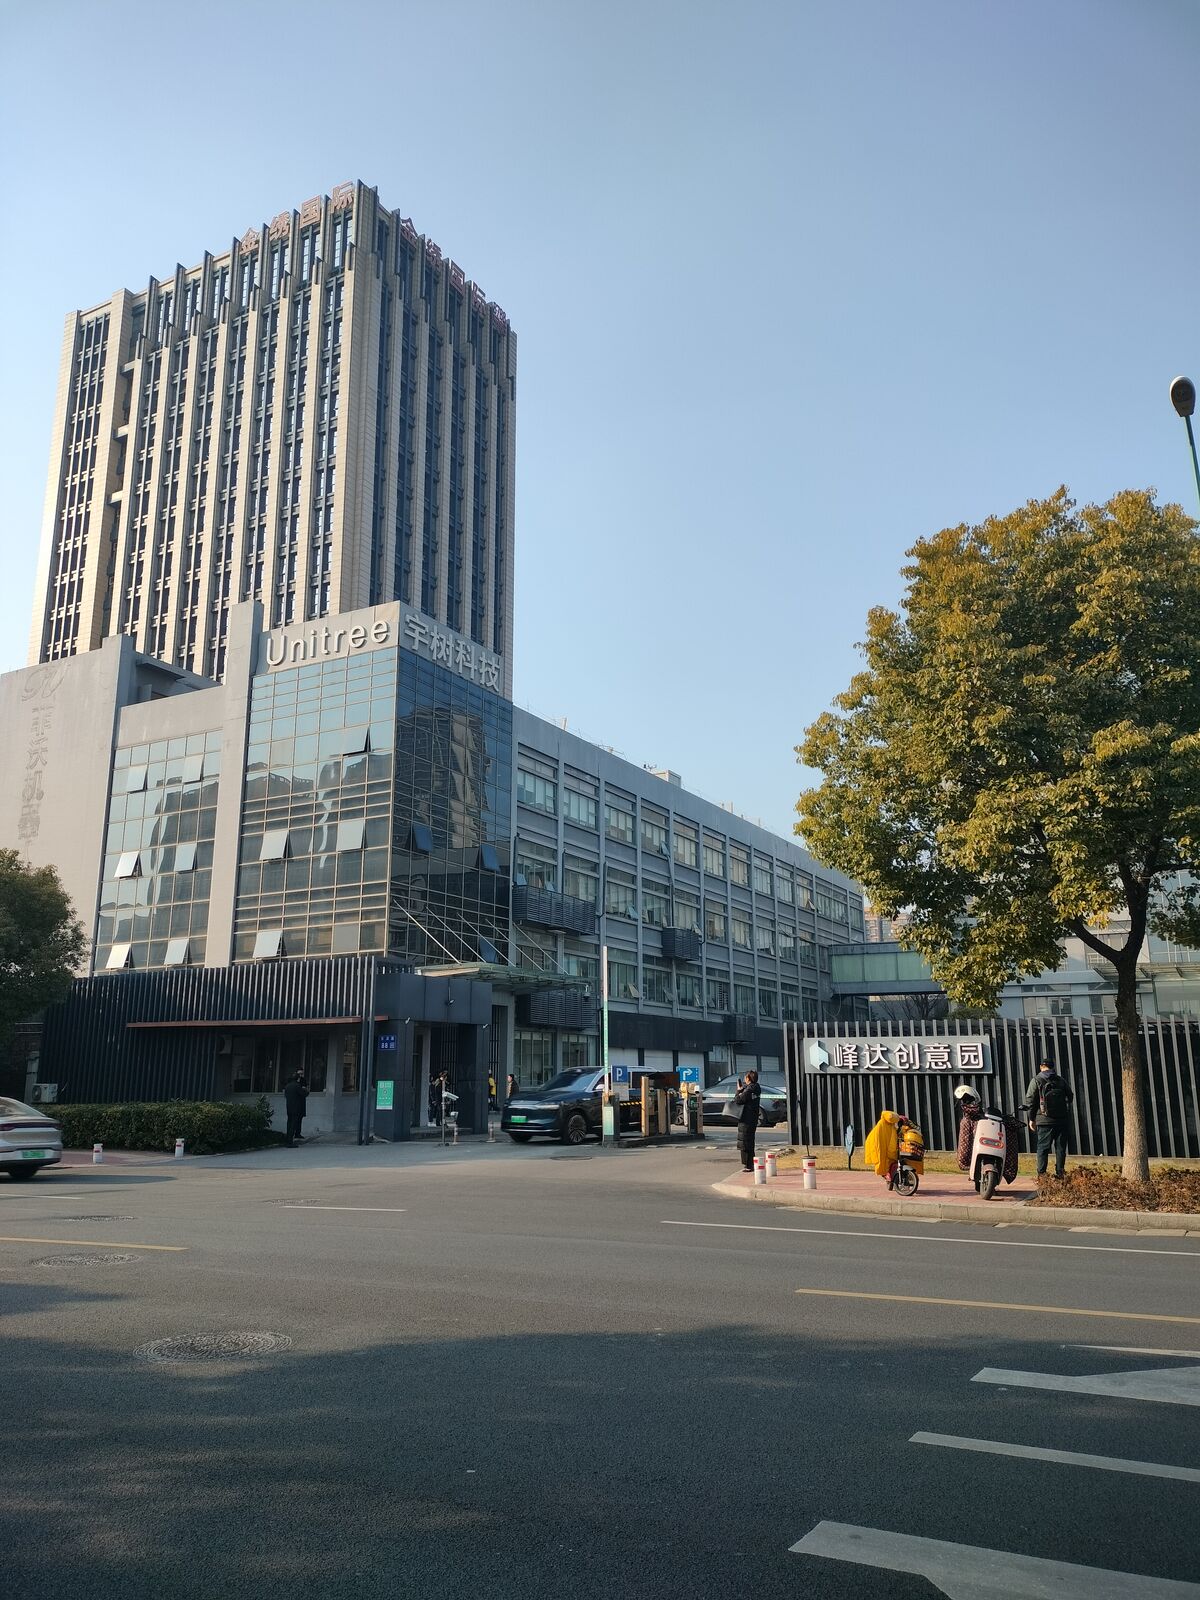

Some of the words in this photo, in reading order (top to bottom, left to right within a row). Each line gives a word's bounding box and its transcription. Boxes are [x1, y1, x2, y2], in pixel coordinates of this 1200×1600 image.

[266, 620, 390, 666] Unitree
[404, 613, 500, 692] 宇树科技
[616, 1067, 623, 1082] P
[833, 1042, 984, 1070] 峰达创意园
